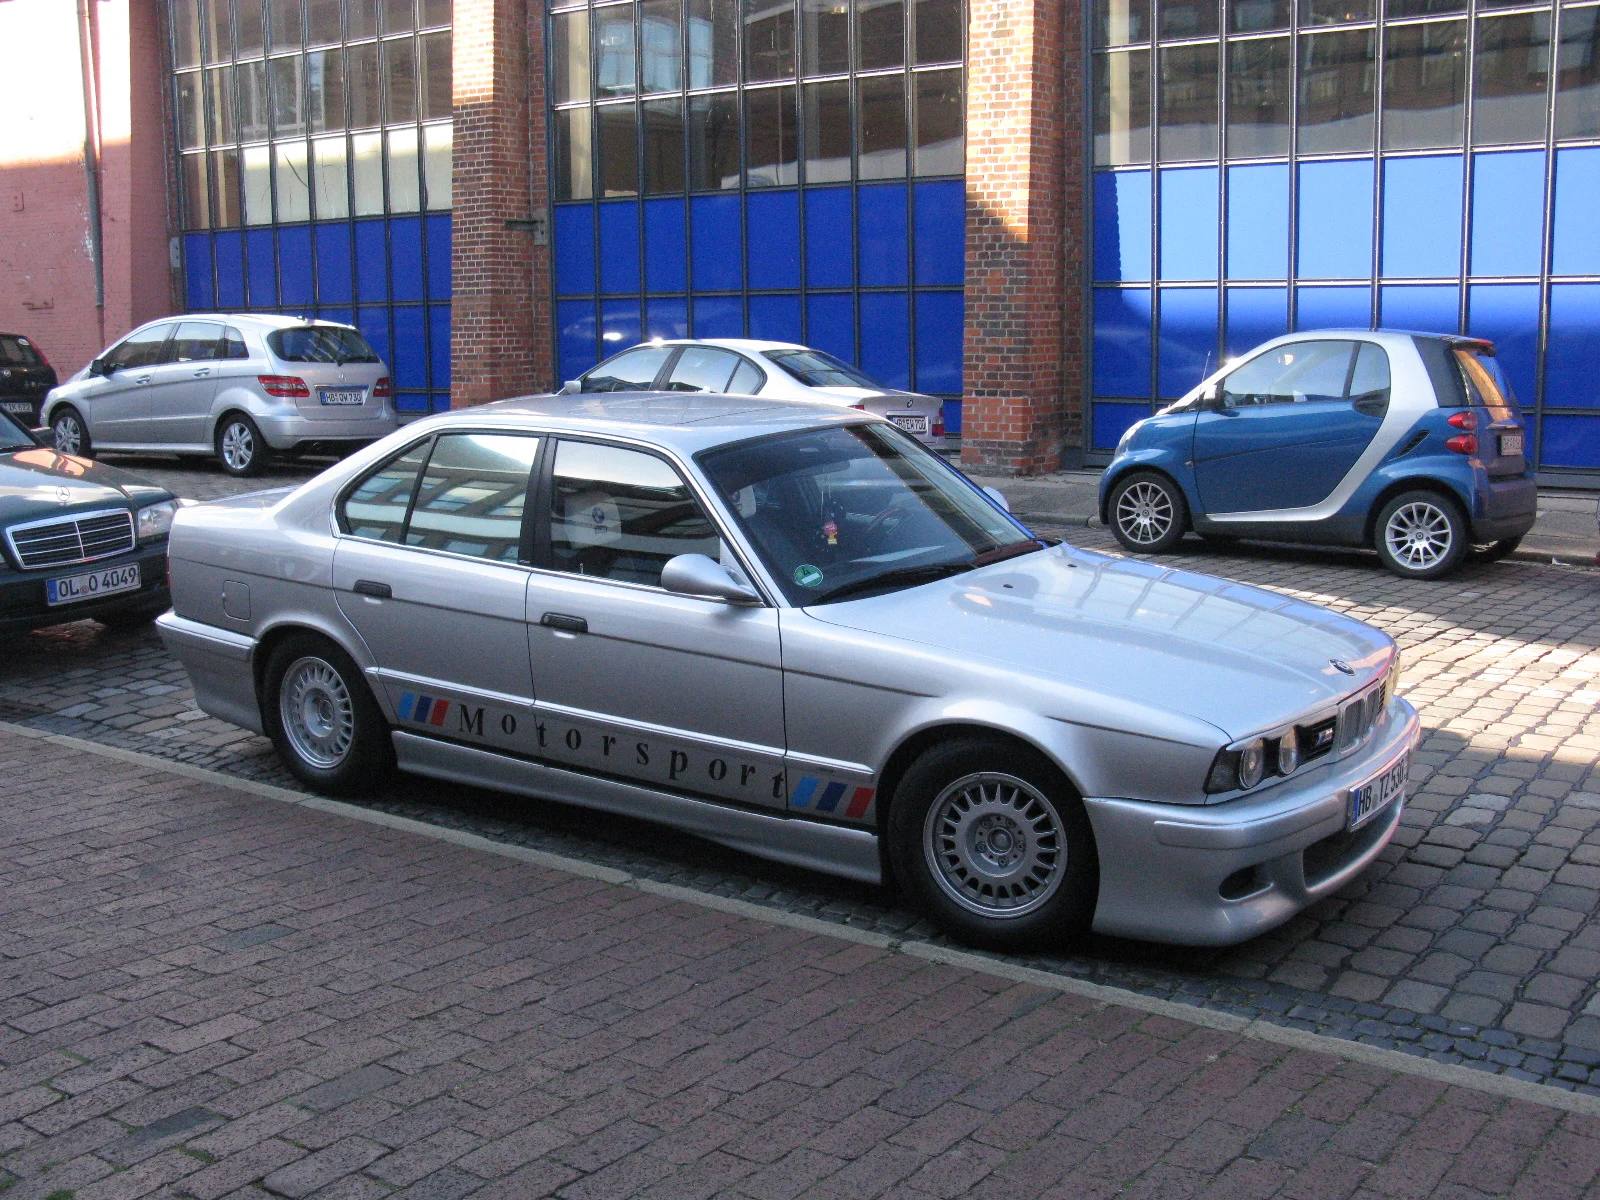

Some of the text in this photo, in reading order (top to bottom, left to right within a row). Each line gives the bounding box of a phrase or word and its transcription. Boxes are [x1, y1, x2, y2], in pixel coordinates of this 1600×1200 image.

[58, 580, 80, 597] OL
[102, 567, 136, 588] 4049
[458, 703, 786, 799] Motorsport
[1358, 784, 1373, 817] HB
